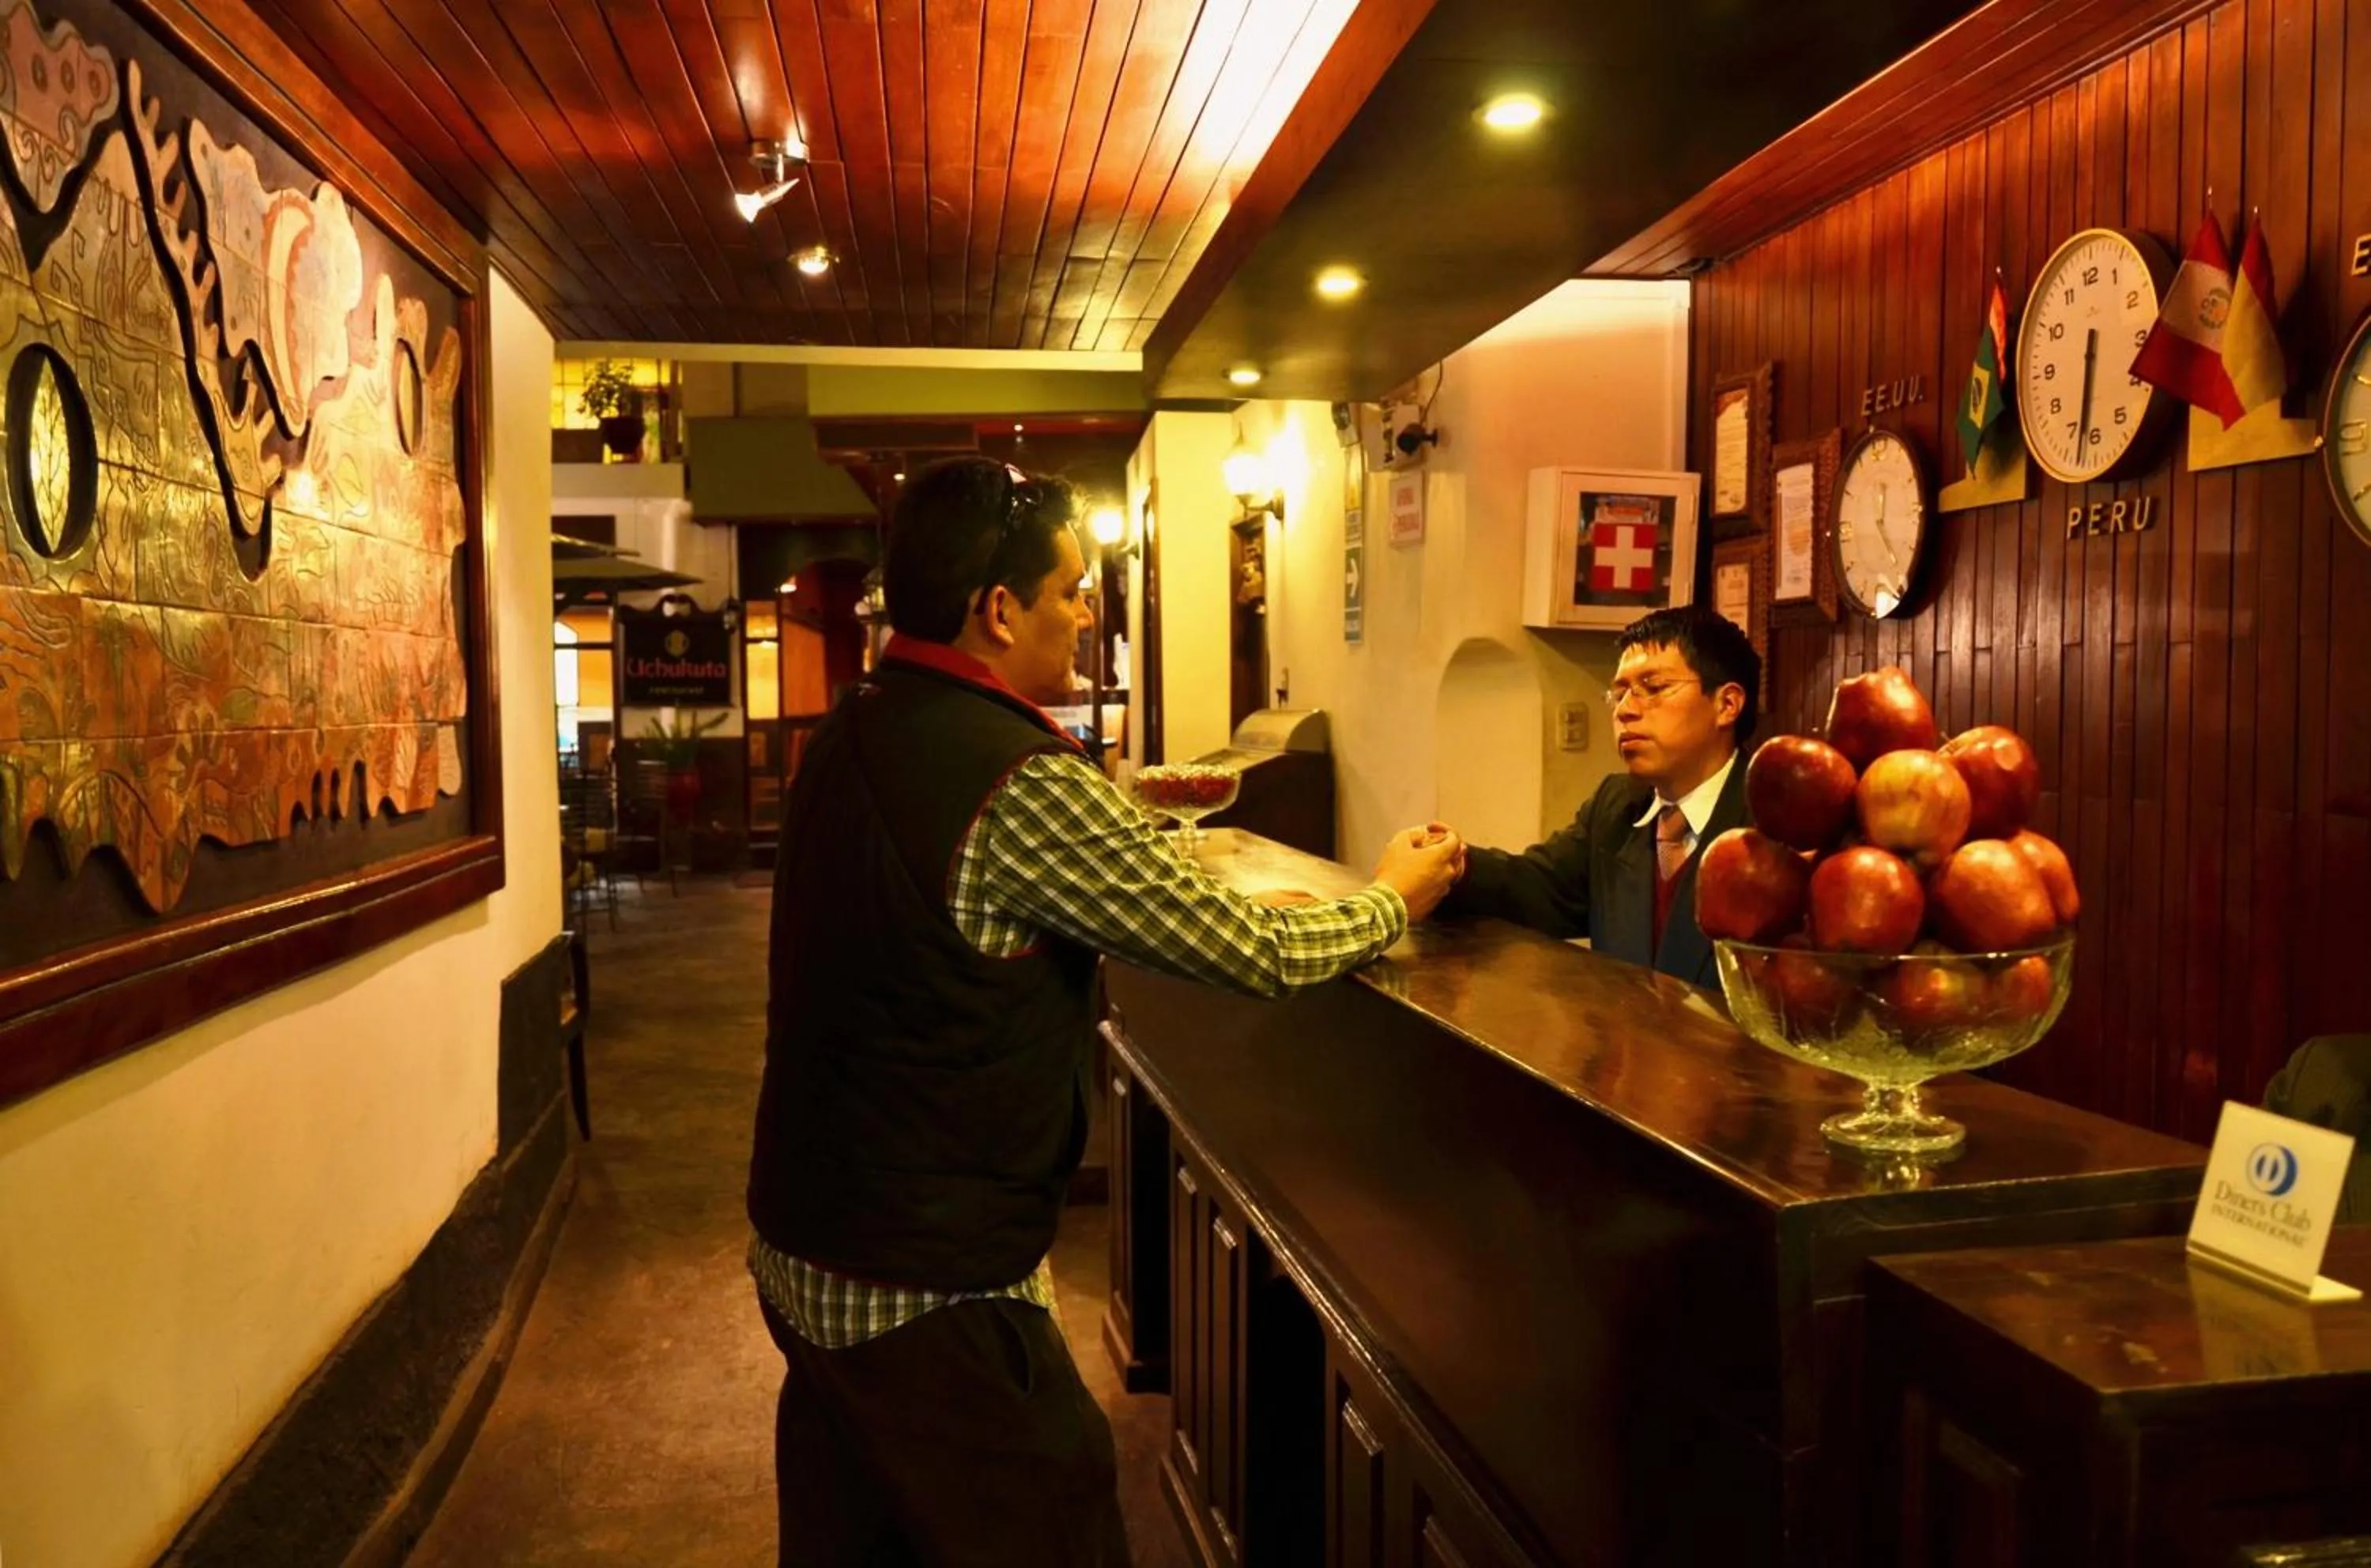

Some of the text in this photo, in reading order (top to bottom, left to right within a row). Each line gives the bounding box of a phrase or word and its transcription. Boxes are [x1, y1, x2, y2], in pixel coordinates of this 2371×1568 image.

[2082, 266, 2099, 285] 12
[2112, 268, 2118, 285] 1
[2064, 288, 2075, 304] 11
[2126, 291, 2139, 310] 2
[2049, 325, 2064, 341] 10
[2134, 329, 2147, 348] 3
[2044, 364, 2056, 381] 9
[2049, 398, 2062, 415] 8
[2113, 406, 2127, 424] 5
[2066, 422, 2078, 440] 7
[2089, 428, 2101, 446] 6
[2066, 496, 2151, 541] PERU
[2215, 1180, 2312, 1231] Diners Club
